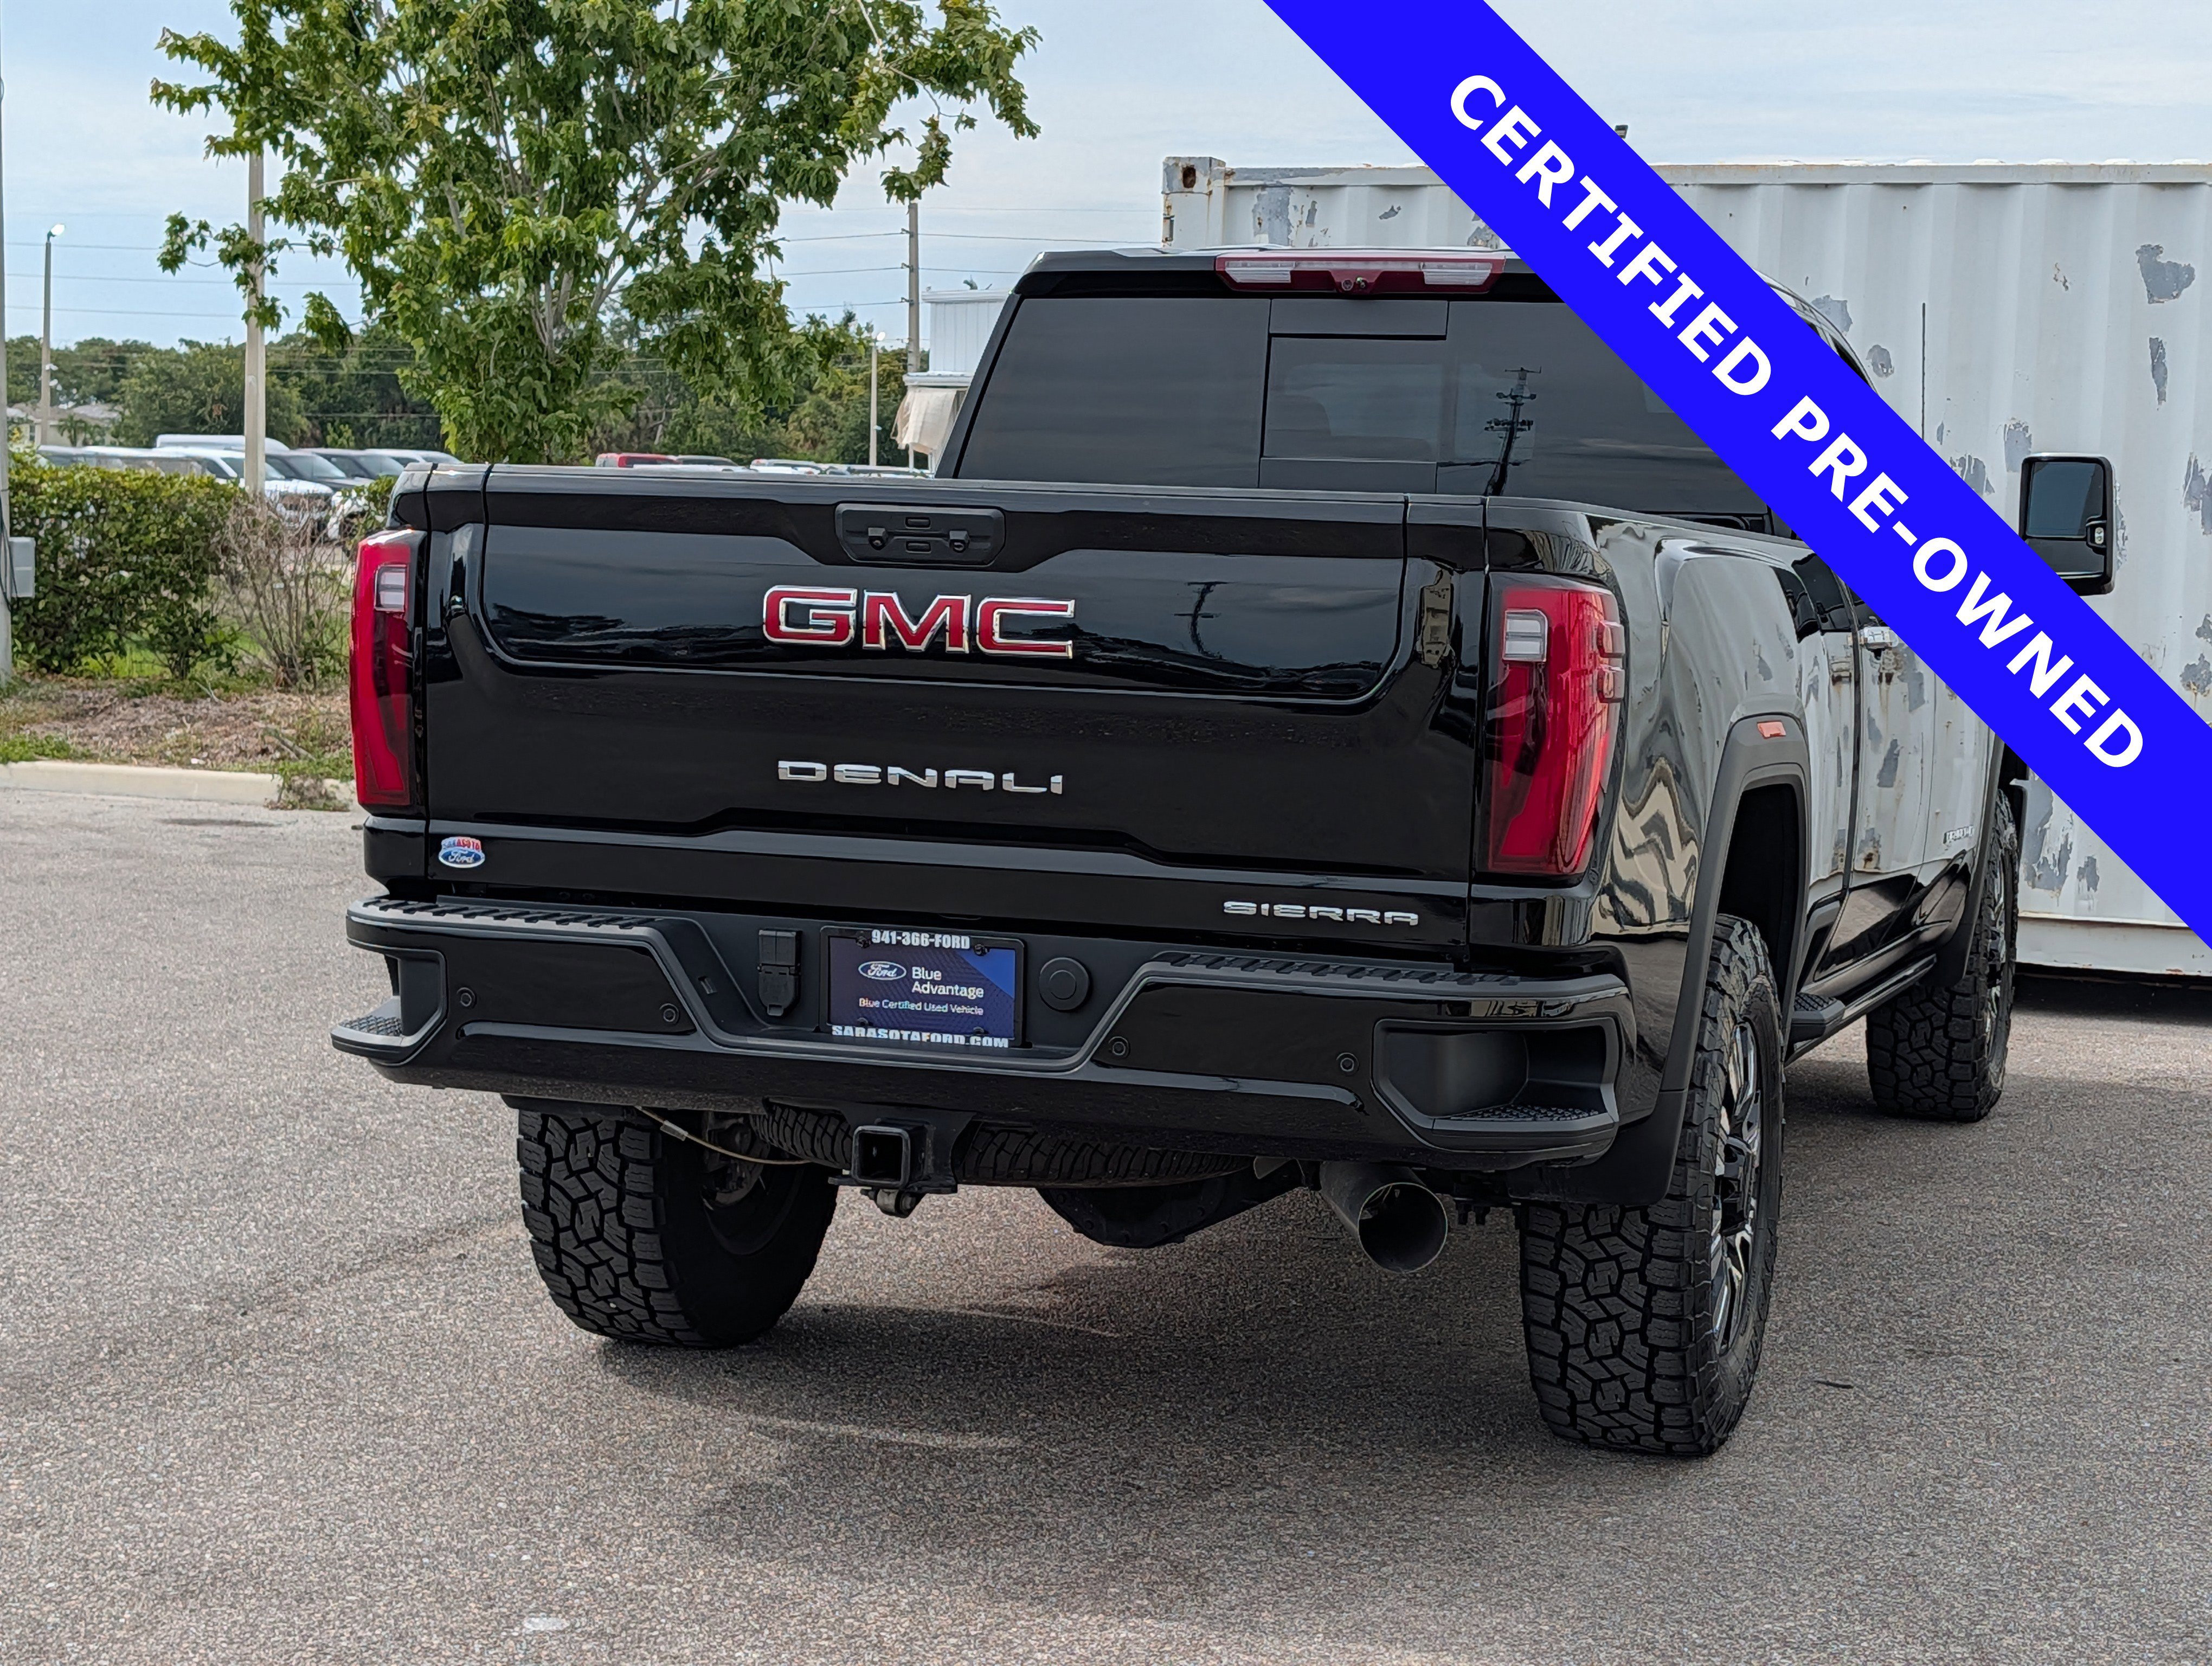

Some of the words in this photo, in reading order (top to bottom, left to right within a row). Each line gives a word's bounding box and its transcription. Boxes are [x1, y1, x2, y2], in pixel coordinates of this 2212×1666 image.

[763, 585, 1075, 659] GMC
[778, 761, 1063, 794] DENALI
[1224, 901, 1418, 926] SIERRA
[871, 930, 970, 949] 941-366-FORD
[867, 964, 897, 977] Ford
[912, 966, 942, 981] Blue
[912, 981, 984, 999] Advantage
[859, 998, 880, 1007] Blue
[882, 999, 922, 1010] Certified
[924, 1003, 948, 1013] Used
[950, 1004, 984, 1015] Vehicle
[832, 1024, 1009, 1048] SARASOTAFORD.COM
